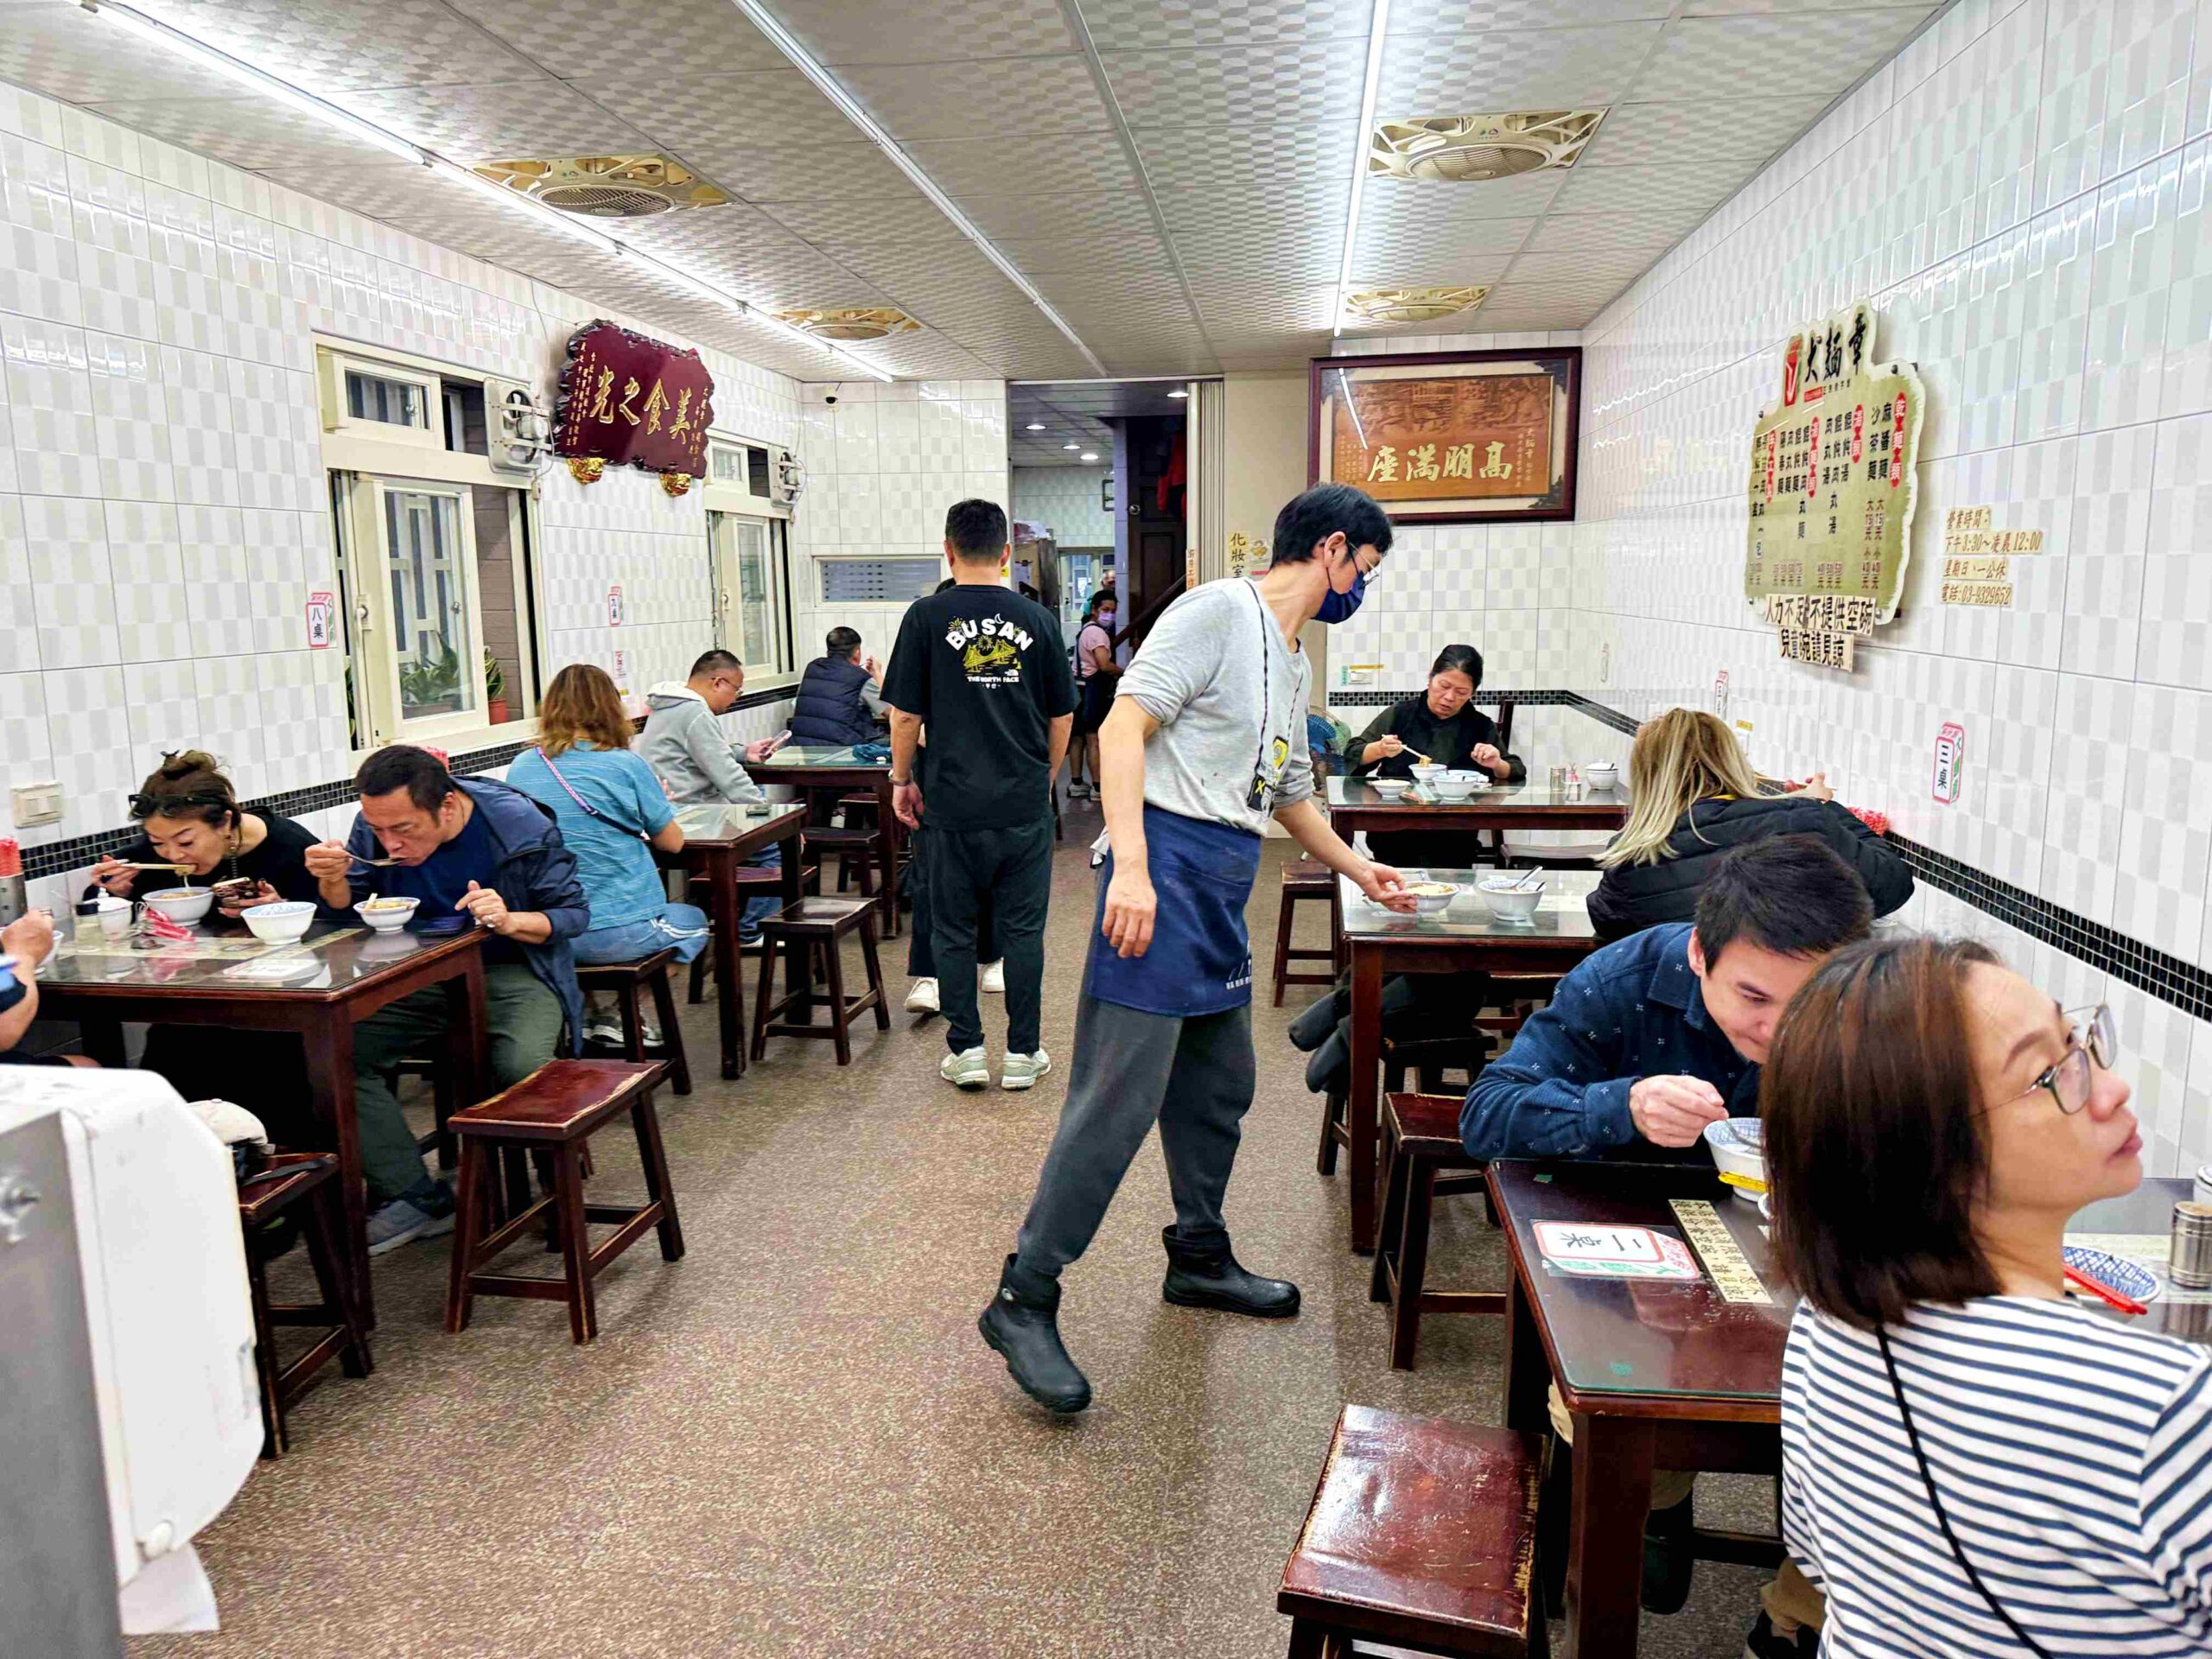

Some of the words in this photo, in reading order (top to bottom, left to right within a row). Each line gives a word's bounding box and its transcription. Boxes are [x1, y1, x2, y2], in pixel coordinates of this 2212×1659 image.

[1368, 442, 1513, 482] 高朋滿座
[312, 607, 324, 639] 八桌
[945, 618, 1033, 652] BUSAN
[1781, 628, 1845, 669] 兒童碗請見諒
[1937, 744, 1949, 790] 三桌
[1560, 1231, 1643, 1253] 二桌
